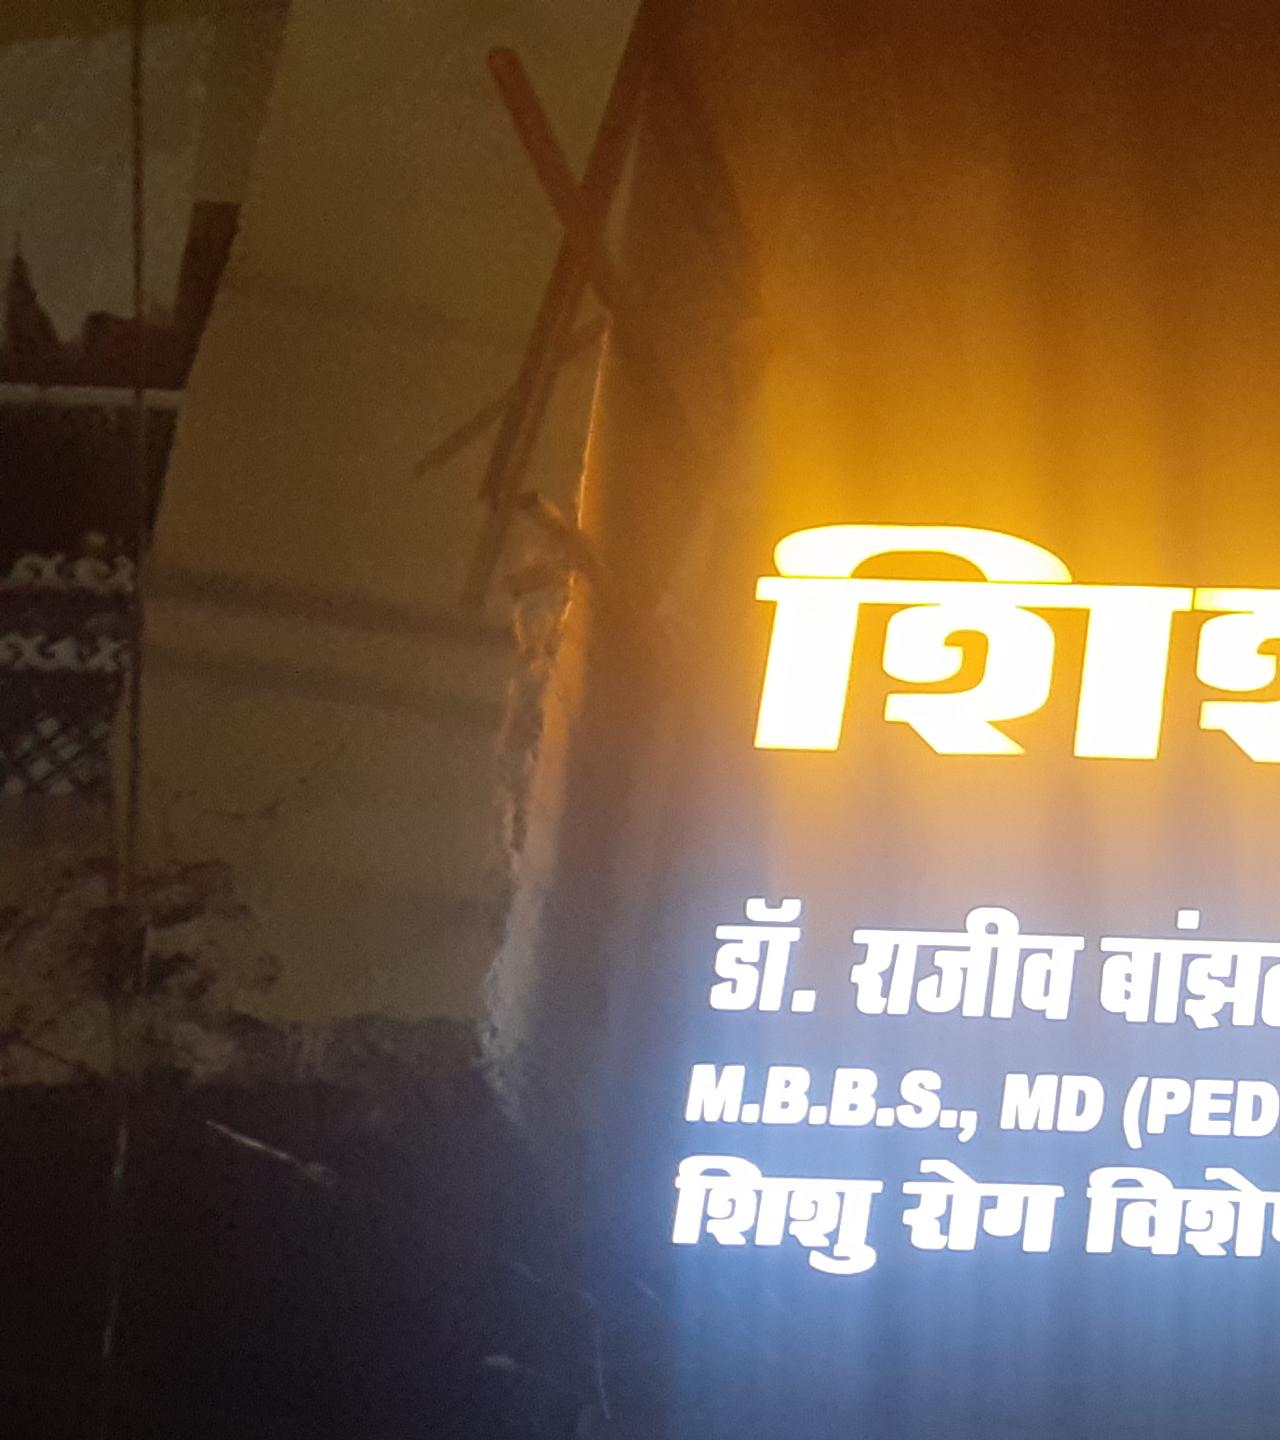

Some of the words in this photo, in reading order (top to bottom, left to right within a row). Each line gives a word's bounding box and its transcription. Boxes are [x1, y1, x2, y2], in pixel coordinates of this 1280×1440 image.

[709, 897, 818, 1014] डॉ.
[849, 906, 1086, 1021] राजीव
[684, 1063, 979, 1144] M.B.B.S.,
[999, 1072, 1106, 1133] MD
[672, 1154, 884, 1276] शिशु
[901, 1158, 1066, 1252] रोग
